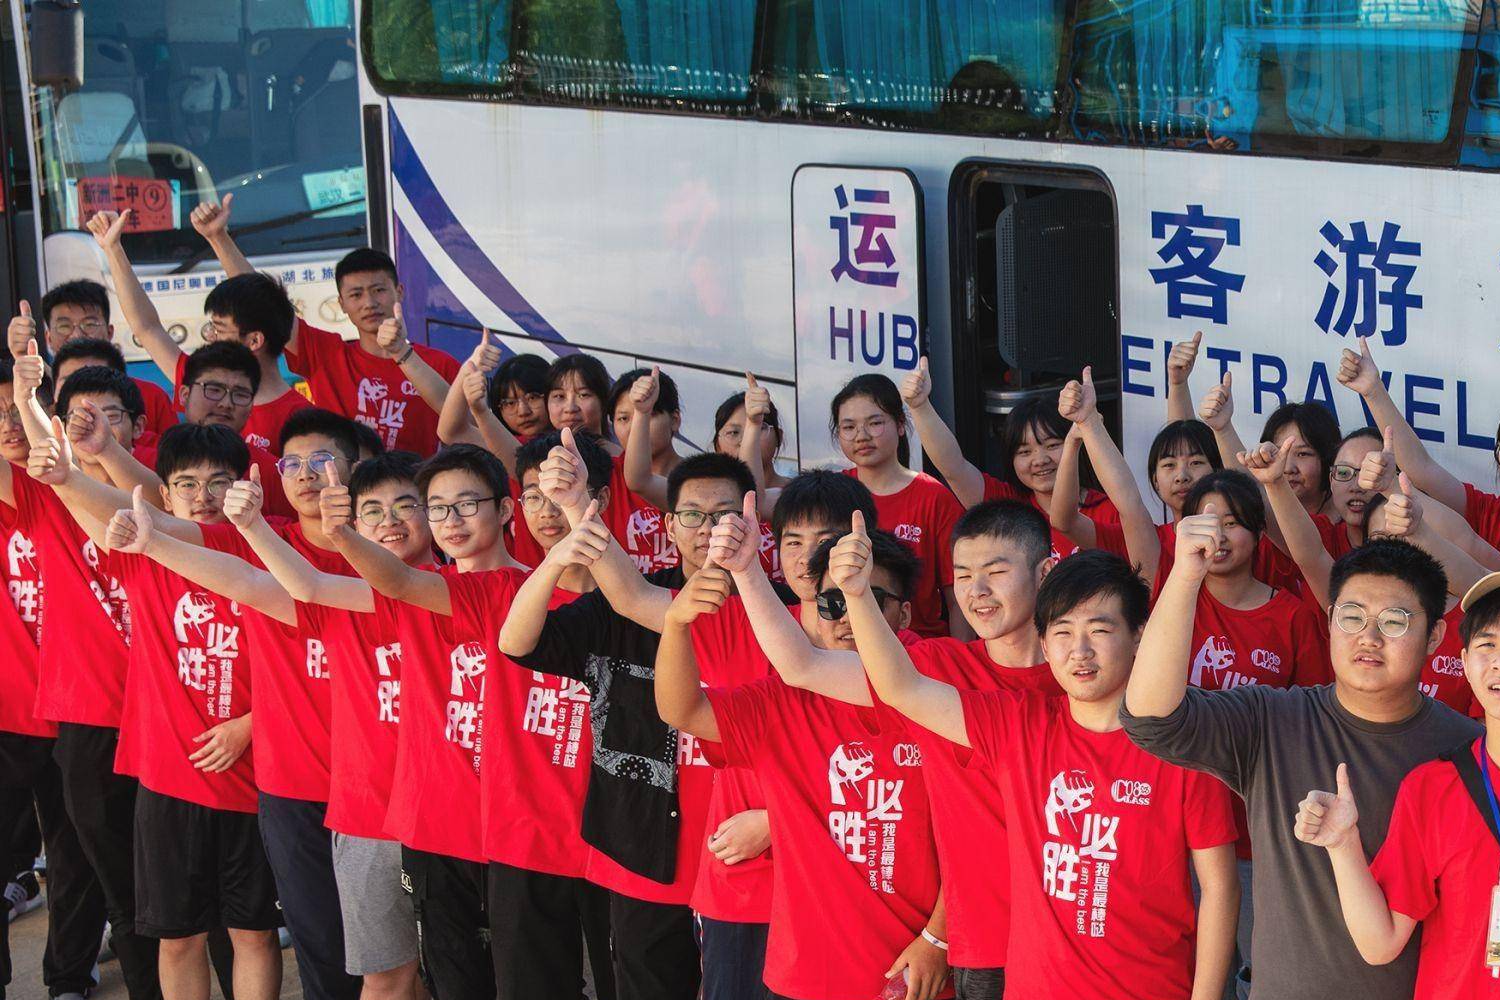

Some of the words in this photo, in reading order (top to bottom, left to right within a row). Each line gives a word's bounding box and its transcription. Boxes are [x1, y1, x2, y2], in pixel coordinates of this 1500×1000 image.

[829, 184, 899, 288] 运
[829, 306, 919, 371] HUB
[1079, 813, 1120, 861] 必
[1079, 866, 1089, 885] am
[1077, 888, 1089, 907] the
[1076, 909, 1089, 935] best
